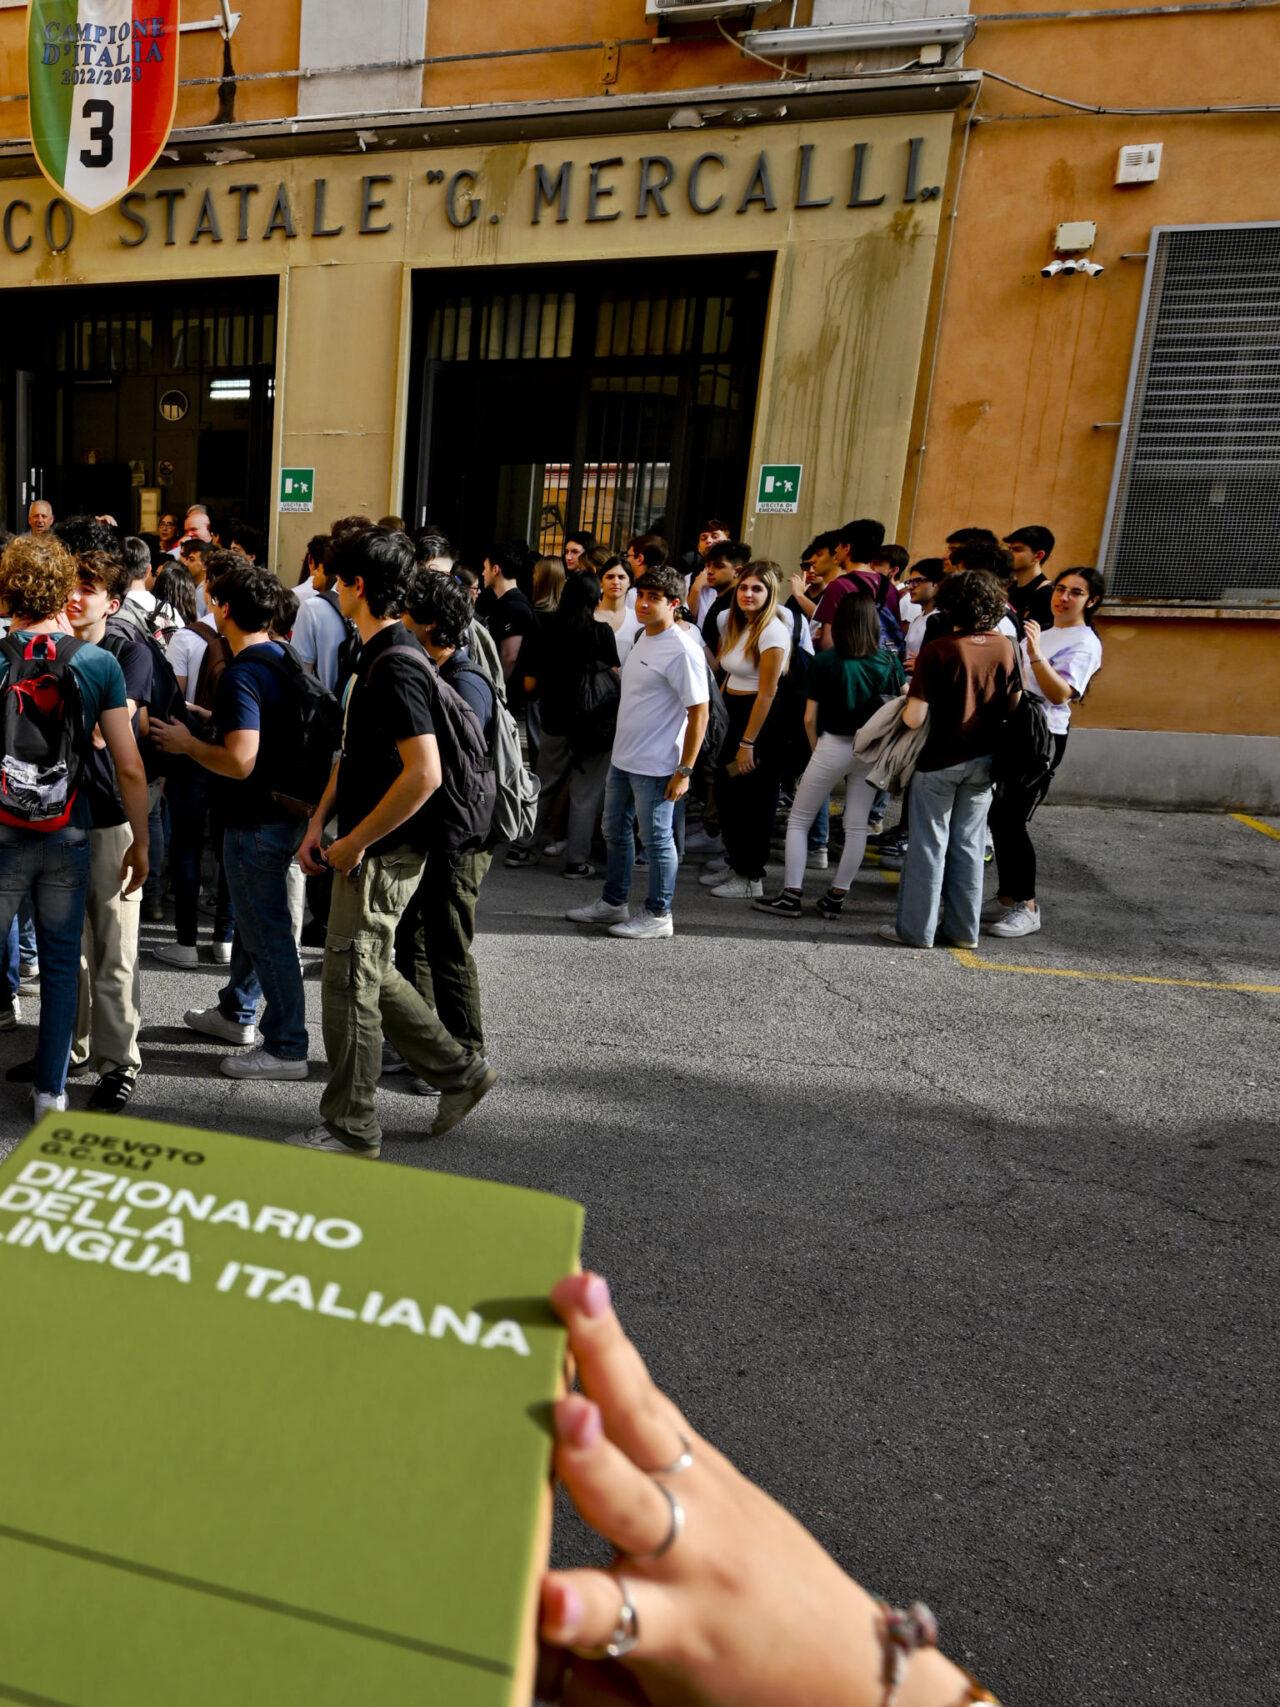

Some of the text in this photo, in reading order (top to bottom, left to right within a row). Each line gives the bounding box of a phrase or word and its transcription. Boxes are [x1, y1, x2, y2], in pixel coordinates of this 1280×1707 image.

[41, 40, 164, 68] D'ITALIA
[44, 17, 166, 44] CAMPIONE
[61, 66, 141, 86] 2022/2023
[80, 99, 114, 168] 3
[120, 174, 394, 246] STATALE
[15, 1160, 363, 1249] DIZIONARIO
[215, 1261, 532, 1357] ITALIANA
